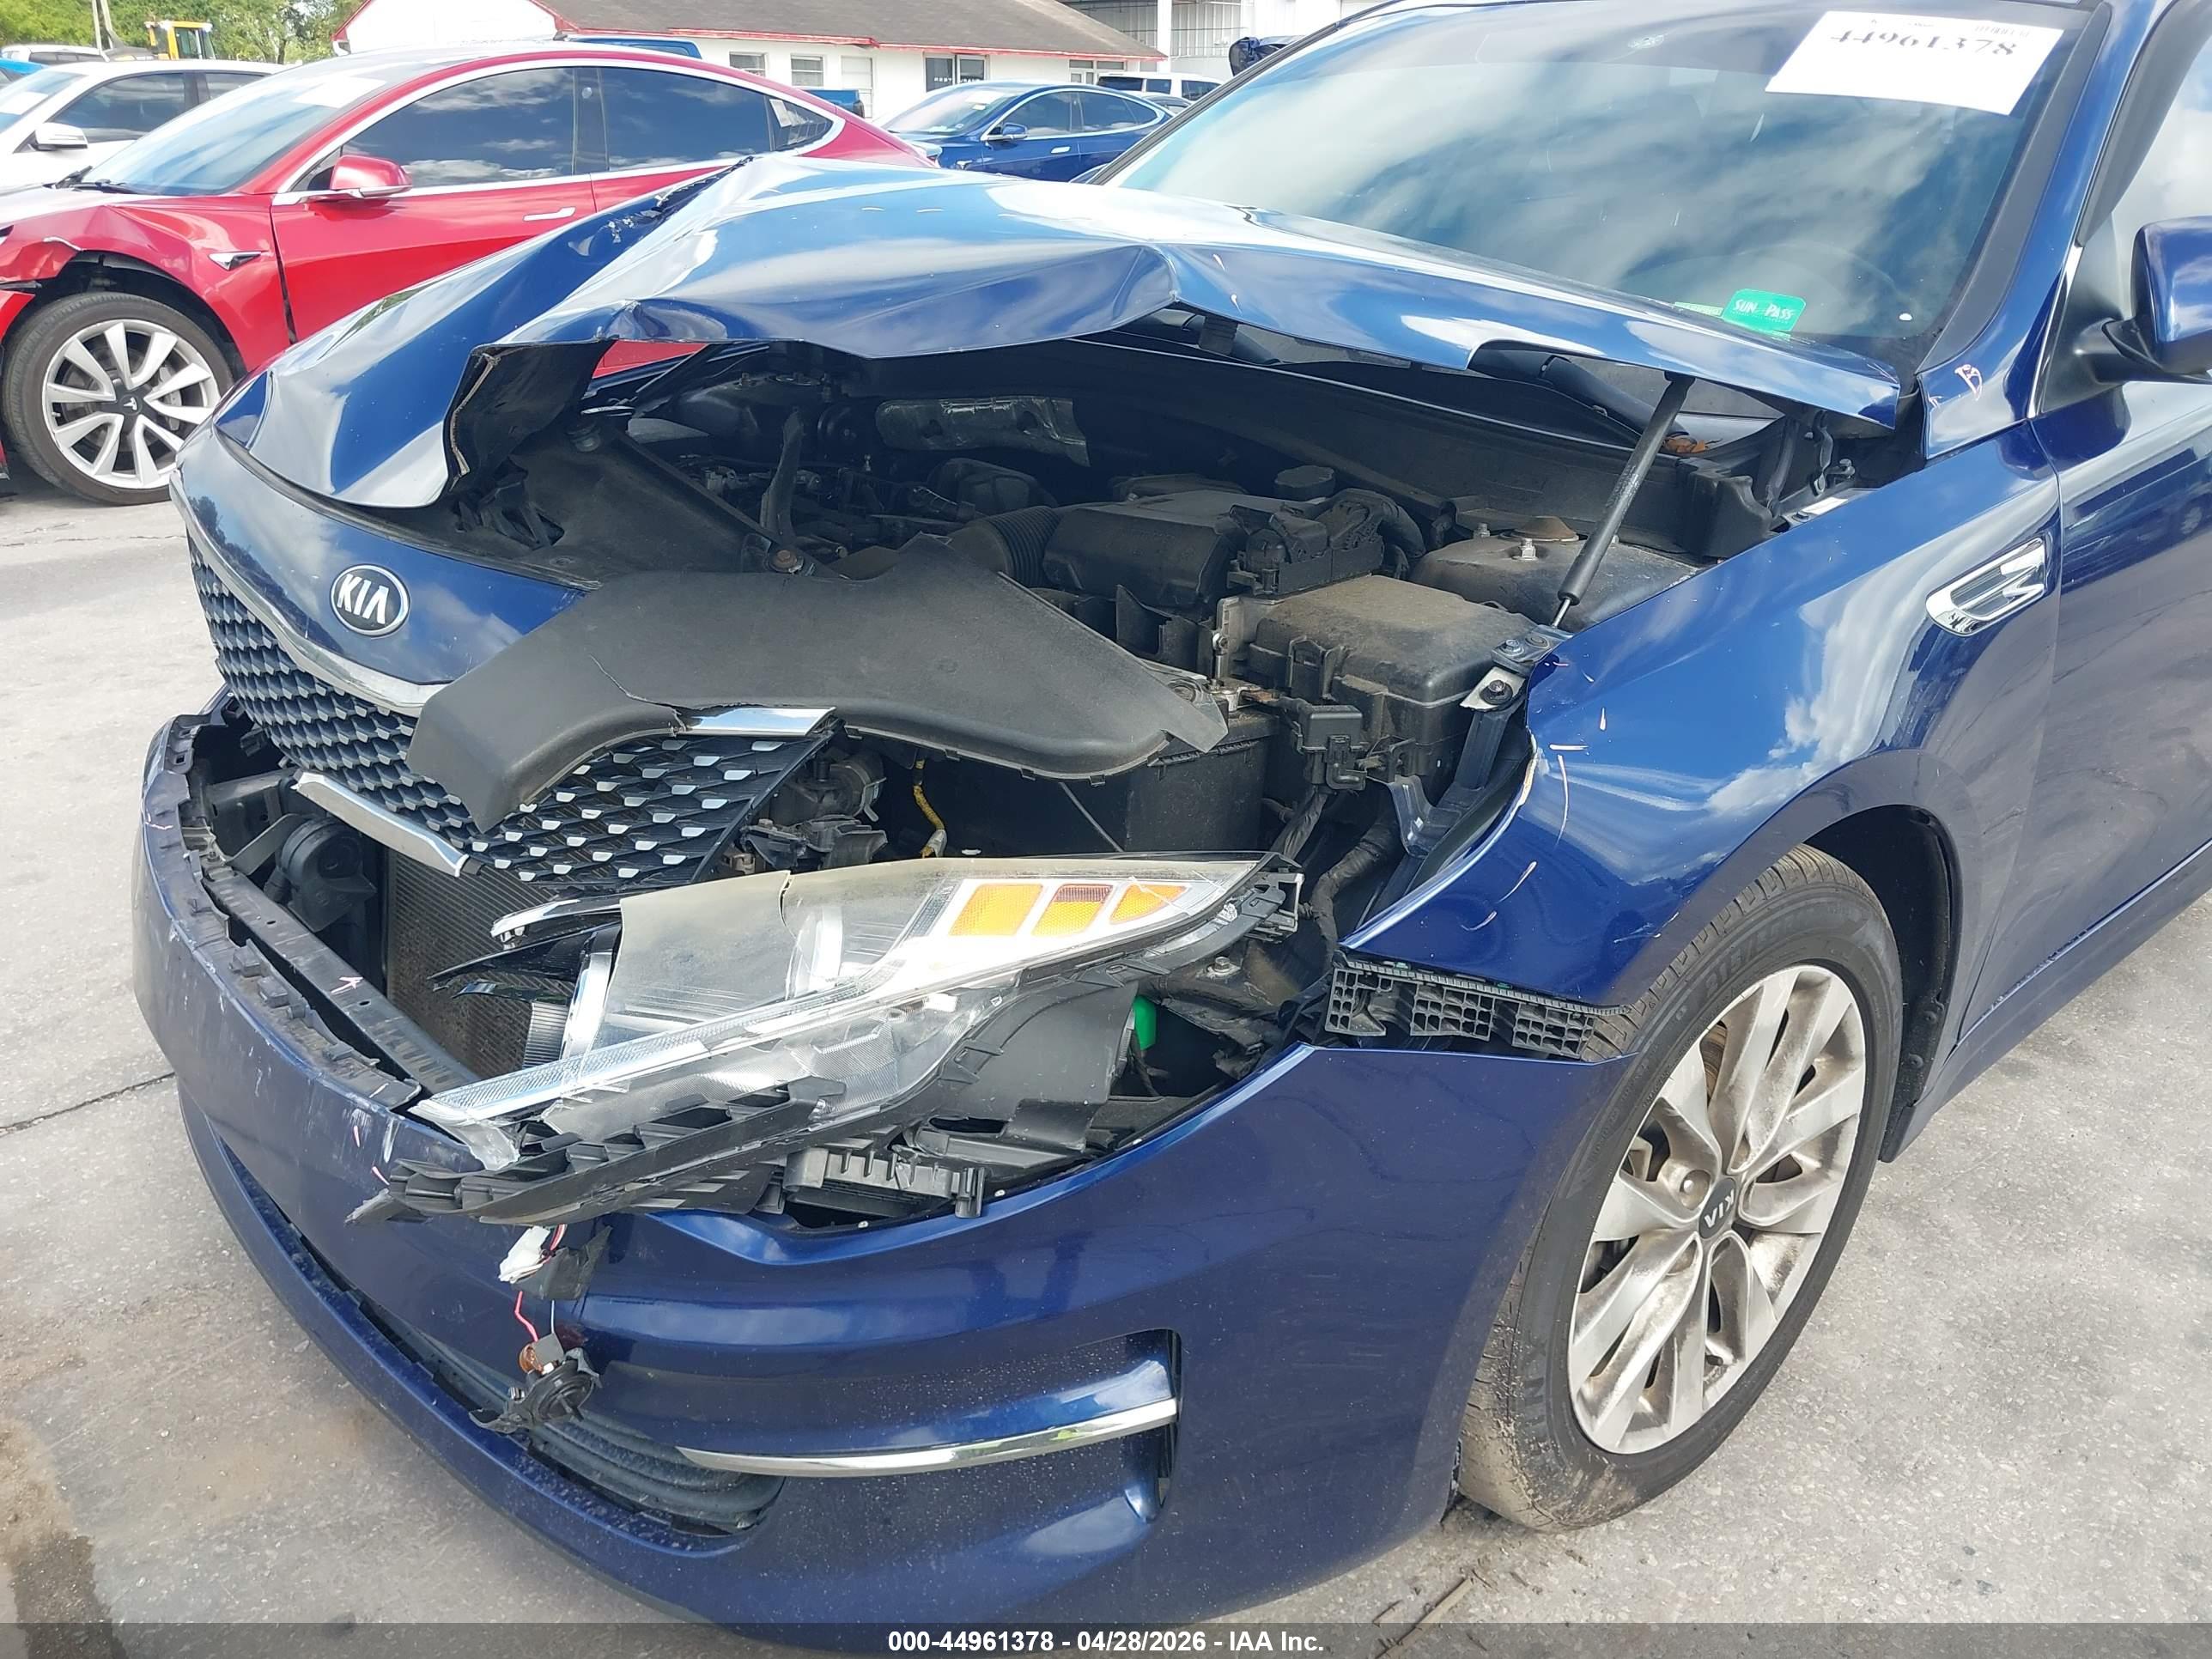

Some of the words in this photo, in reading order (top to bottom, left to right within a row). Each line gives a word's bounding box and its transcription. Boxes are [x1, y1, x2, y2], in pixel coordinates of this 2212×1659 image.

[1831, 30, 2017, 56] 44961378
[1733, 300, 1759, 314] SUN
[1765, 302, 1796, 321] PASS
[337, 573, 390, 625] KIA
[1704, 1188, 1735, 1229] KIA
